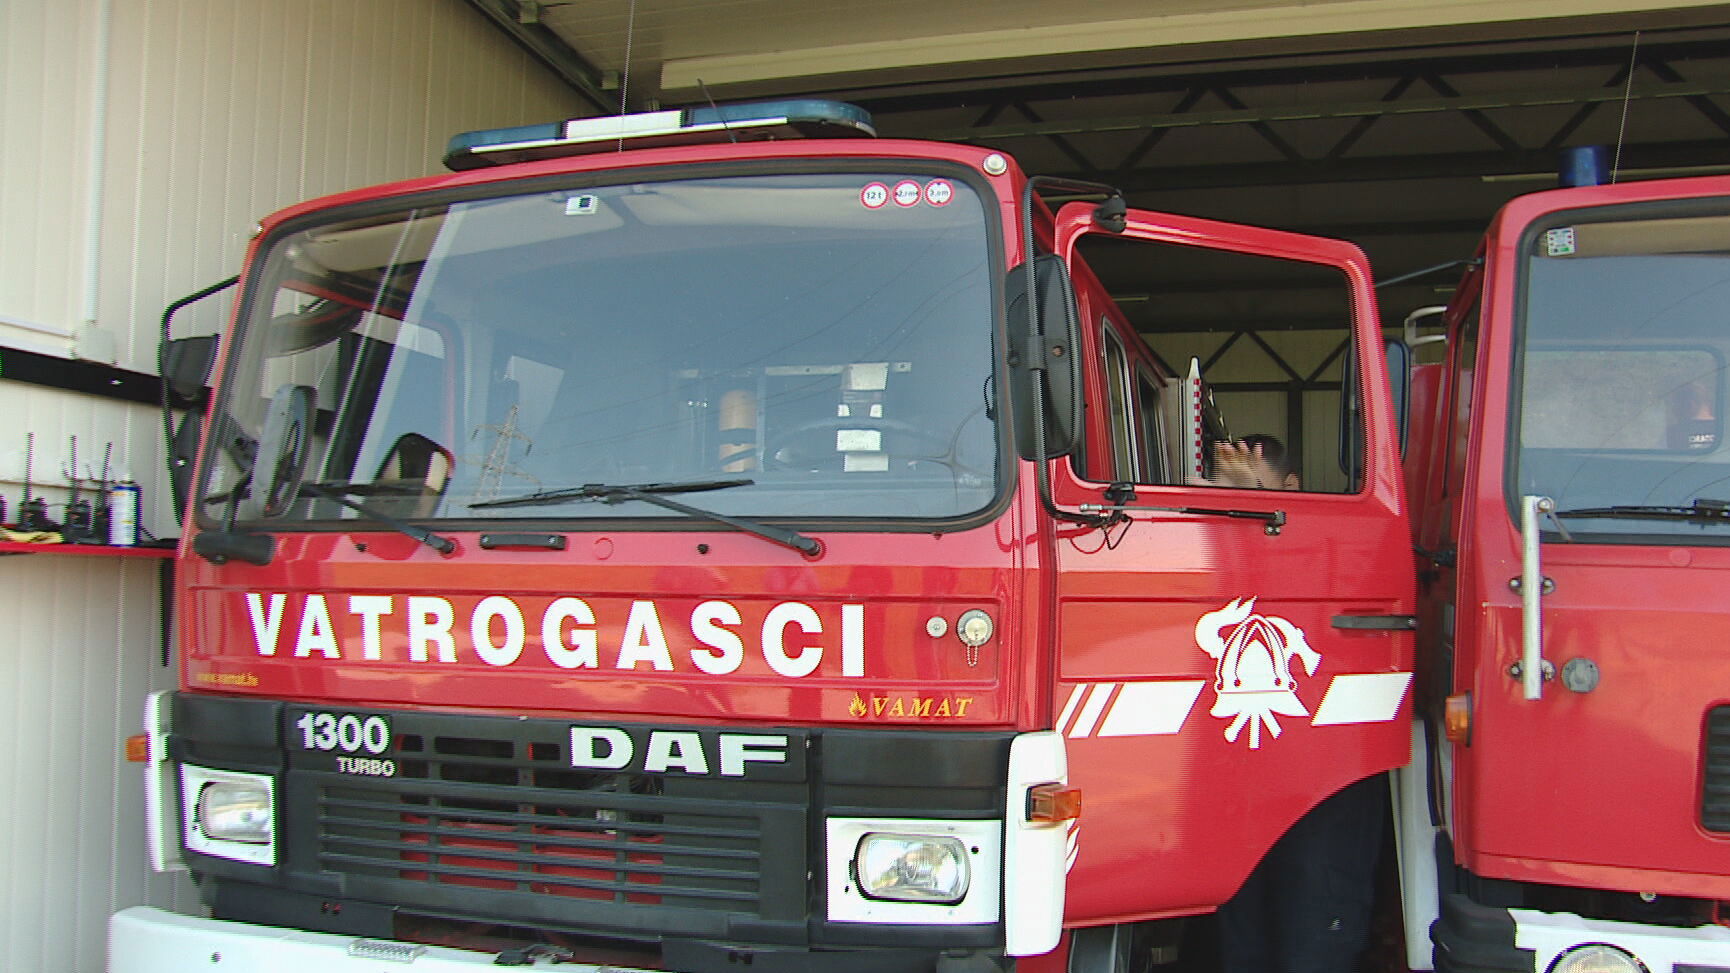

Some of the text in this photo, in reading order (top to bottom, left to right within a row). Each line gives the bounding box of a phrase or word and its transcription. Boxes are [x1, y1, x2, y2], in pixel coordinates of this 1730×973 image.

[246, 592, 866, 678] VATROGASCI
[873, 697, 973, 717] VAMAT
[296, 711, 390, 755] 1300
[570, 725, 788, 777] DAF
[336, 755, 396, 777] TURBO
